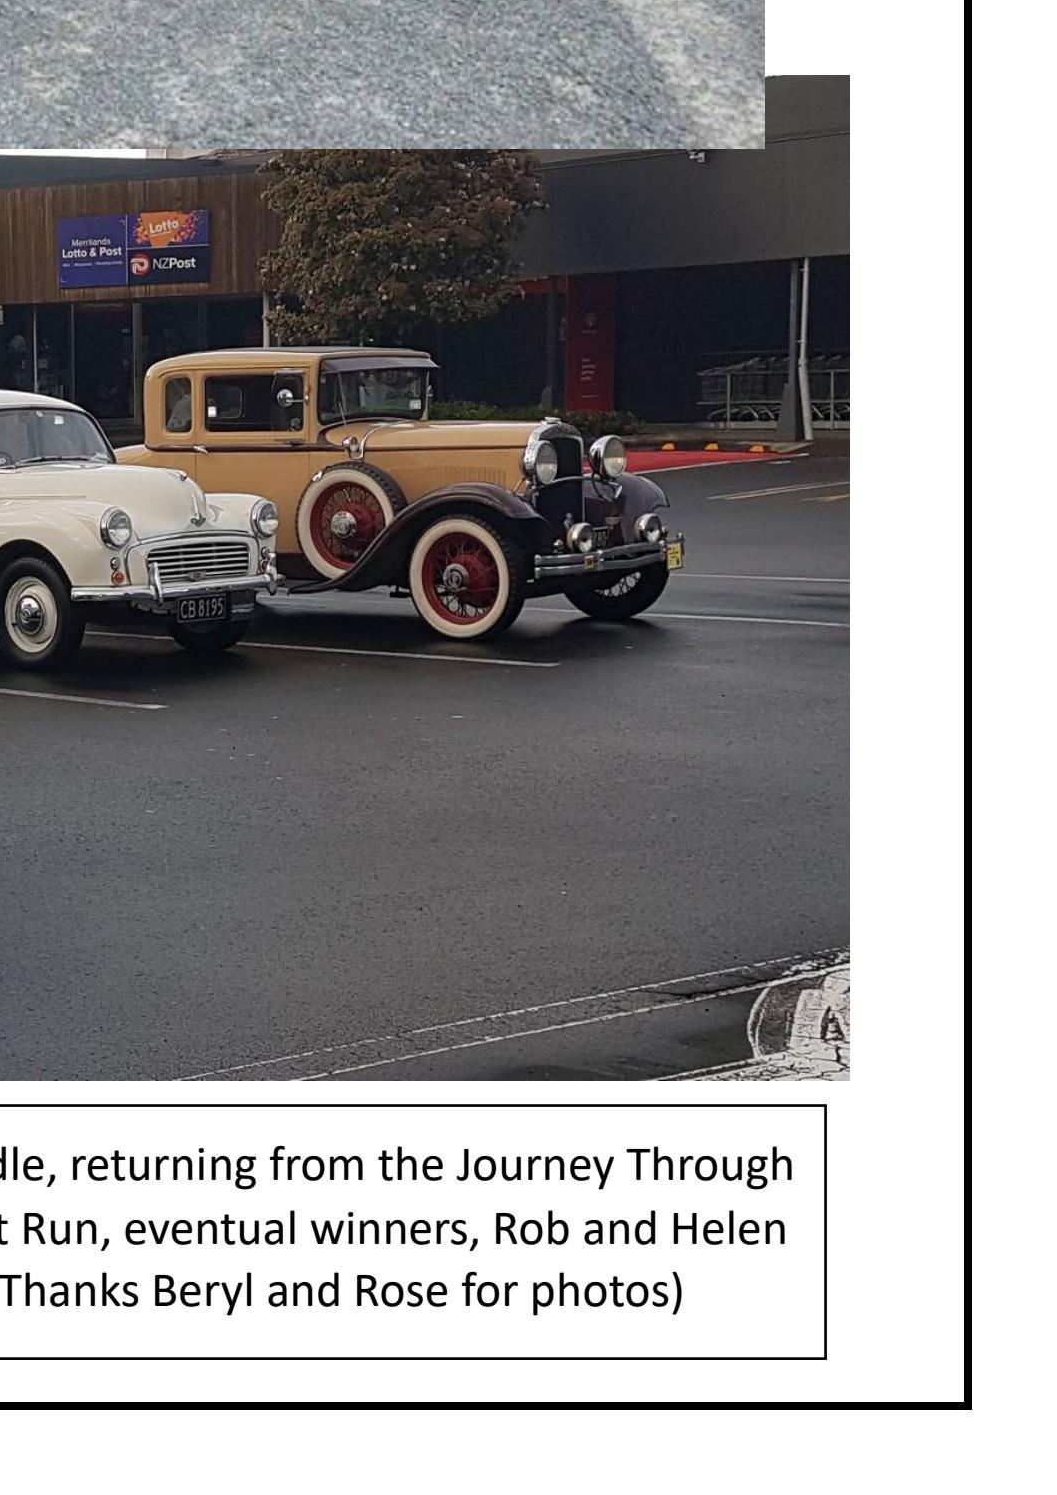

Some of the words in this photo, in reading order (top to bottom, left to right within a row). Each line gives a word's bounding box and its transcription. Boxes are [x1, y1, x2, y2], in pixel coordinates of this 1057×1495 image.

[149, 219, 179, 234] Lotto
[71, 238, 111, 247] Merrilands
[62, 249, 87, 258] Lotto
[89, 248, 97, 256] &
[99, 247, 123, 256] Post
[152, 257, 197, 269] NZPost
[180, 601, 196, 620] CB
[198, 597, 224, 617] 8195
[73, 1148, 256, 1189] returning
[270, 1146, 363, 1181] from
[378, 1147, 443, 1181] the
[457, 1149, 614, 1189] Journey
[627, 1147, 792, 1189] Through
[24, 1213, 109, 1251] Run,
[126, 1211, 294, 1245] eventual
[311, 1212, 478, 1251] winners,
[496, 1211, 569, 1245] Rob
[584, 1211, 655, 1245] and
[674, 1211, 785, 1245] Helen
[155, 1273, 251, 1315] Beryl
[268, 1272, 339, 1307] and
[357, 1275, 447, 1307] Rose
[462, 1272, 518, 1307] for
[533, 1272, 682, 1315] photos)
